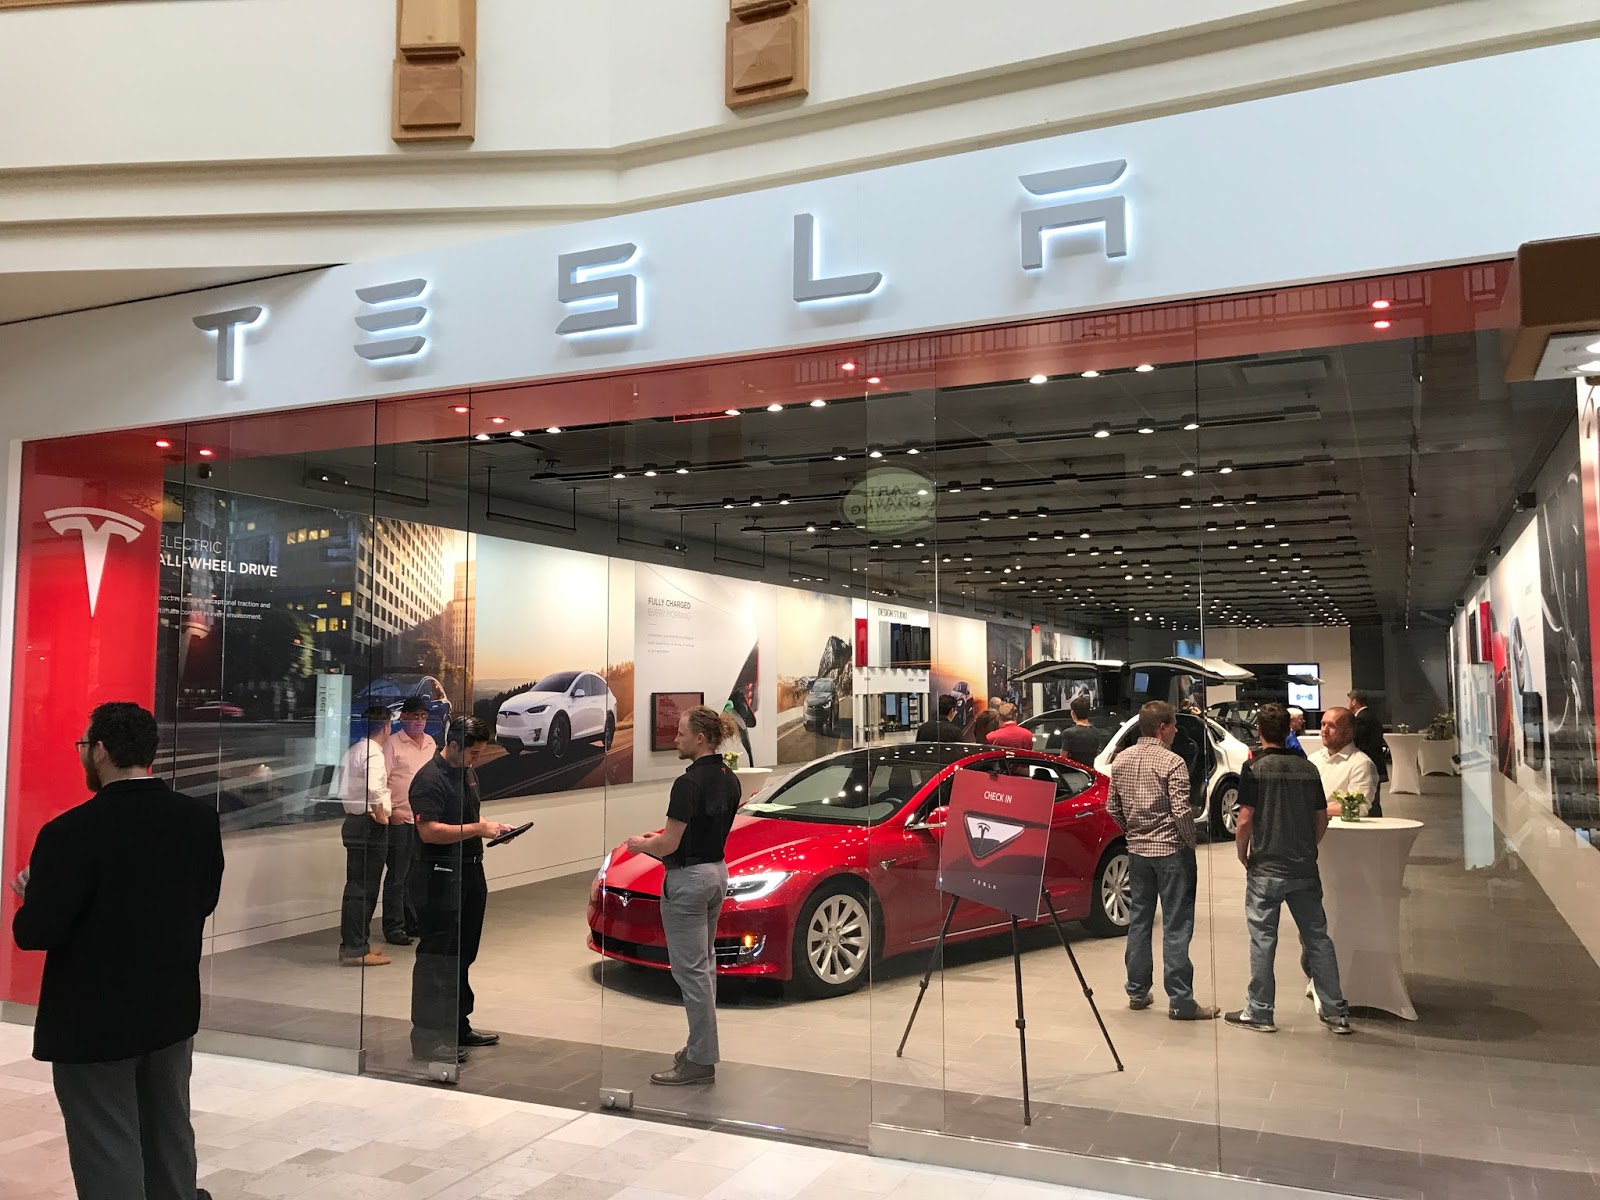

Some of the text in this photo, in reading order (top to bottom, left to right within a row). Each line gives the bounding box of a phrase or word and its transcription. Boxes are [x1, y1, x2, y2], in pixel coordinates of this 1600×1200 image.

[192, 159, 1128, 382] TESLA
[159, 553, 278, 577] ALL-WHEEL DRIVE
[205, 599, 236, 607] exceptonal
[648, 597, 691, 609] FULLY CHARGED
[984, 791, 1013, 804] CHECK IN
